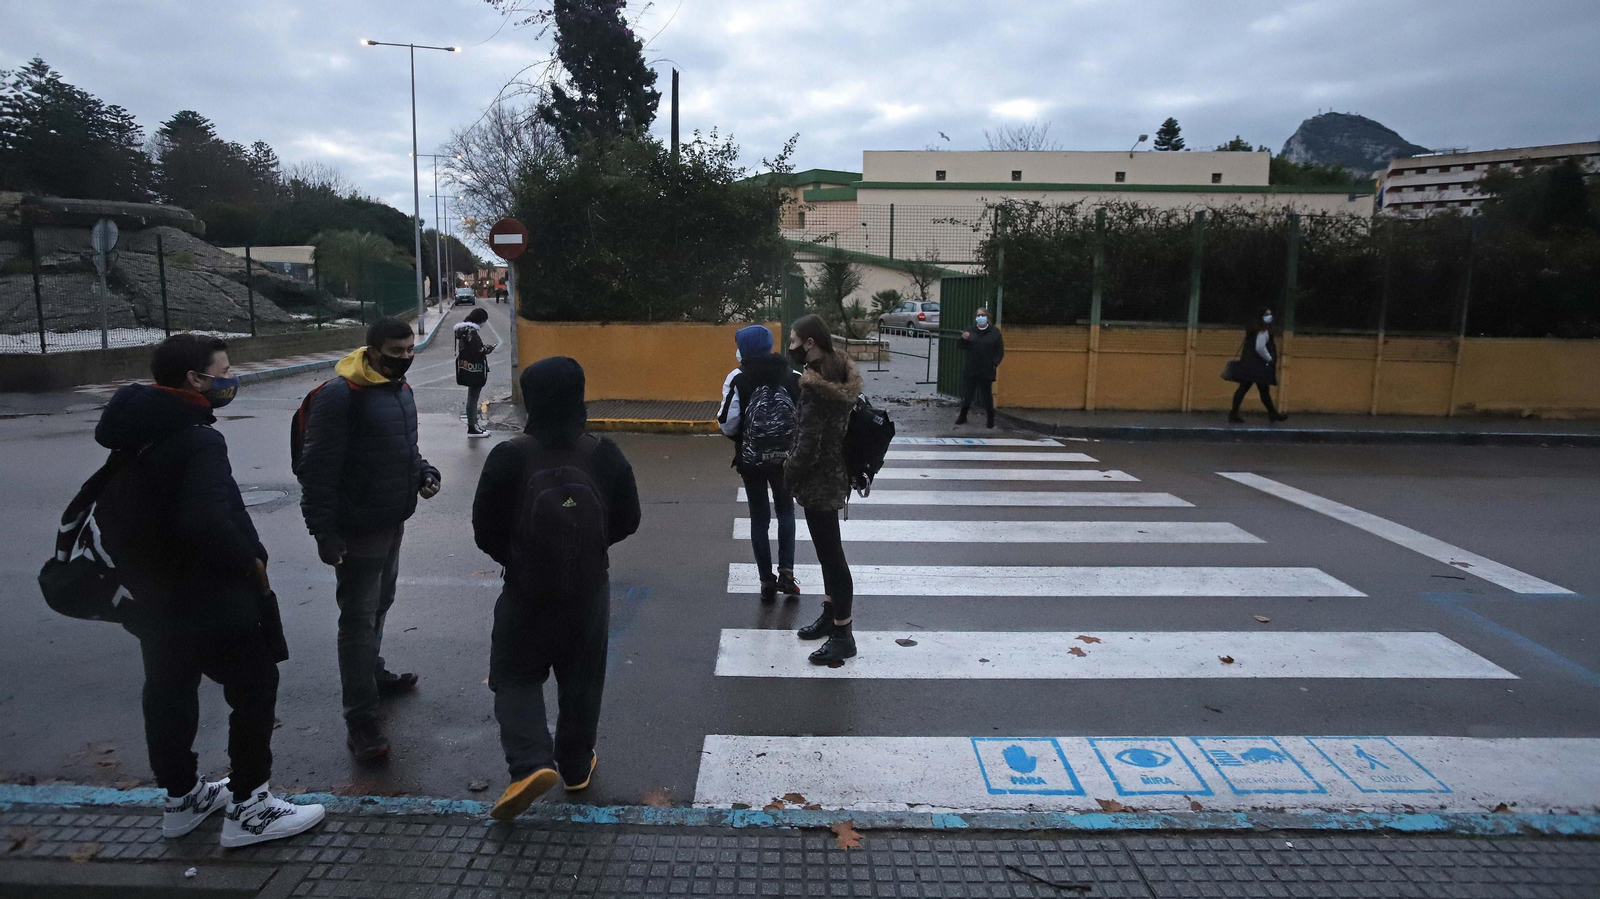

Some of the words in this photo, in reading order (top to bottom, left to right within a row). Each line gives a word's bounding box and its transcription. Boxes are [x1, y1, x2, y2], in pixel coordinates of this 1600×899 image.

[460, 359, 483, 370] PROUD
[1009, 776, 1047, 785] PARA
[1140, 776, 1175, 785] MIRA
[1369, 774, 1415, 783] CRUZA
